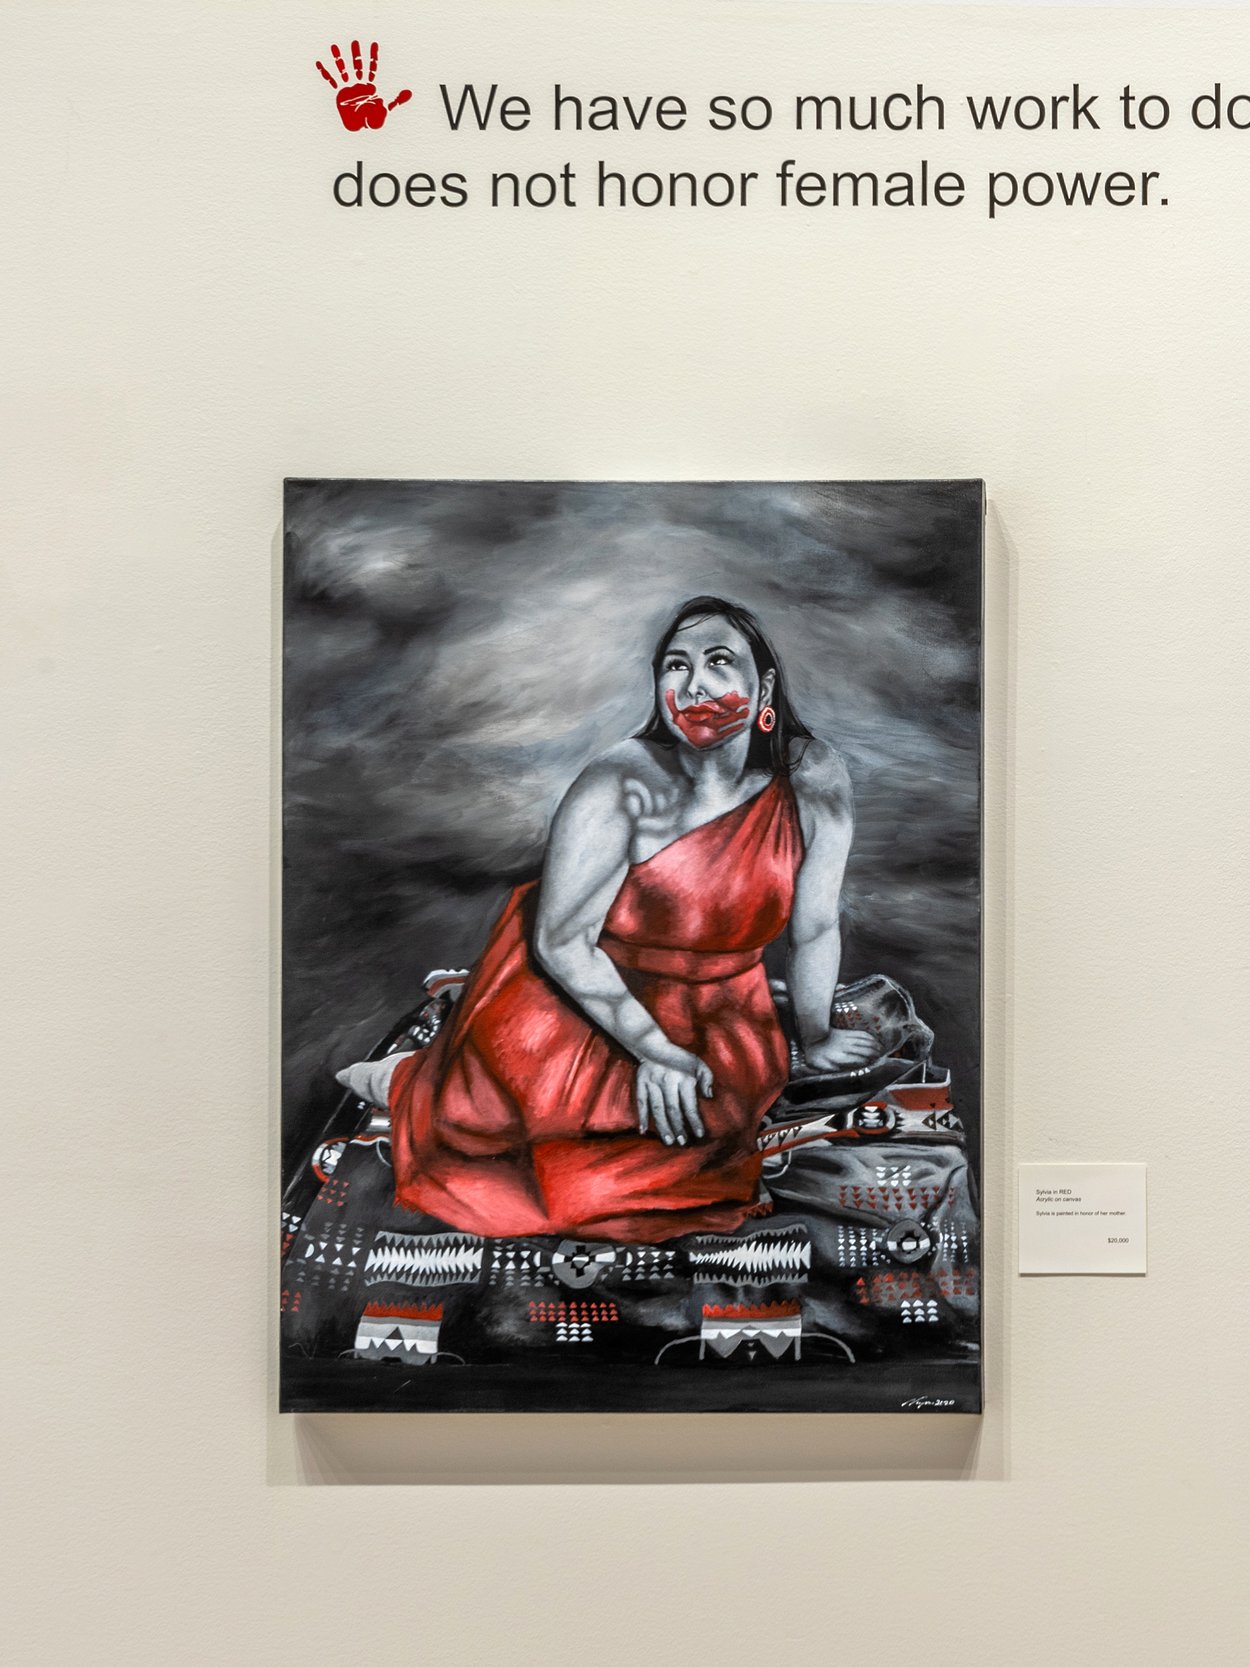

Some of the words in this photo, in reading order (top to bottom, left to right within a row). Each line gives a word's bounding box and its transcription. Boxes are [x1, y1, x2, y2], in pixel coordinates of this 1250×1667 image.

[440, 84, 531, 132] We
[555, 84, 687, 131] have
[709, 95, 773, 131] so
[797, 83, 945, 131] much
[967, 83, 1101, 131] work
[1120, 84, 1170, 130] to
[333, 160, 468, 208] does
[491, 162, 577, 208] not
[598, 160, 759, 207] honor
[775, 159, 965, 207] female
[988, 171, 1169, 218] power.
